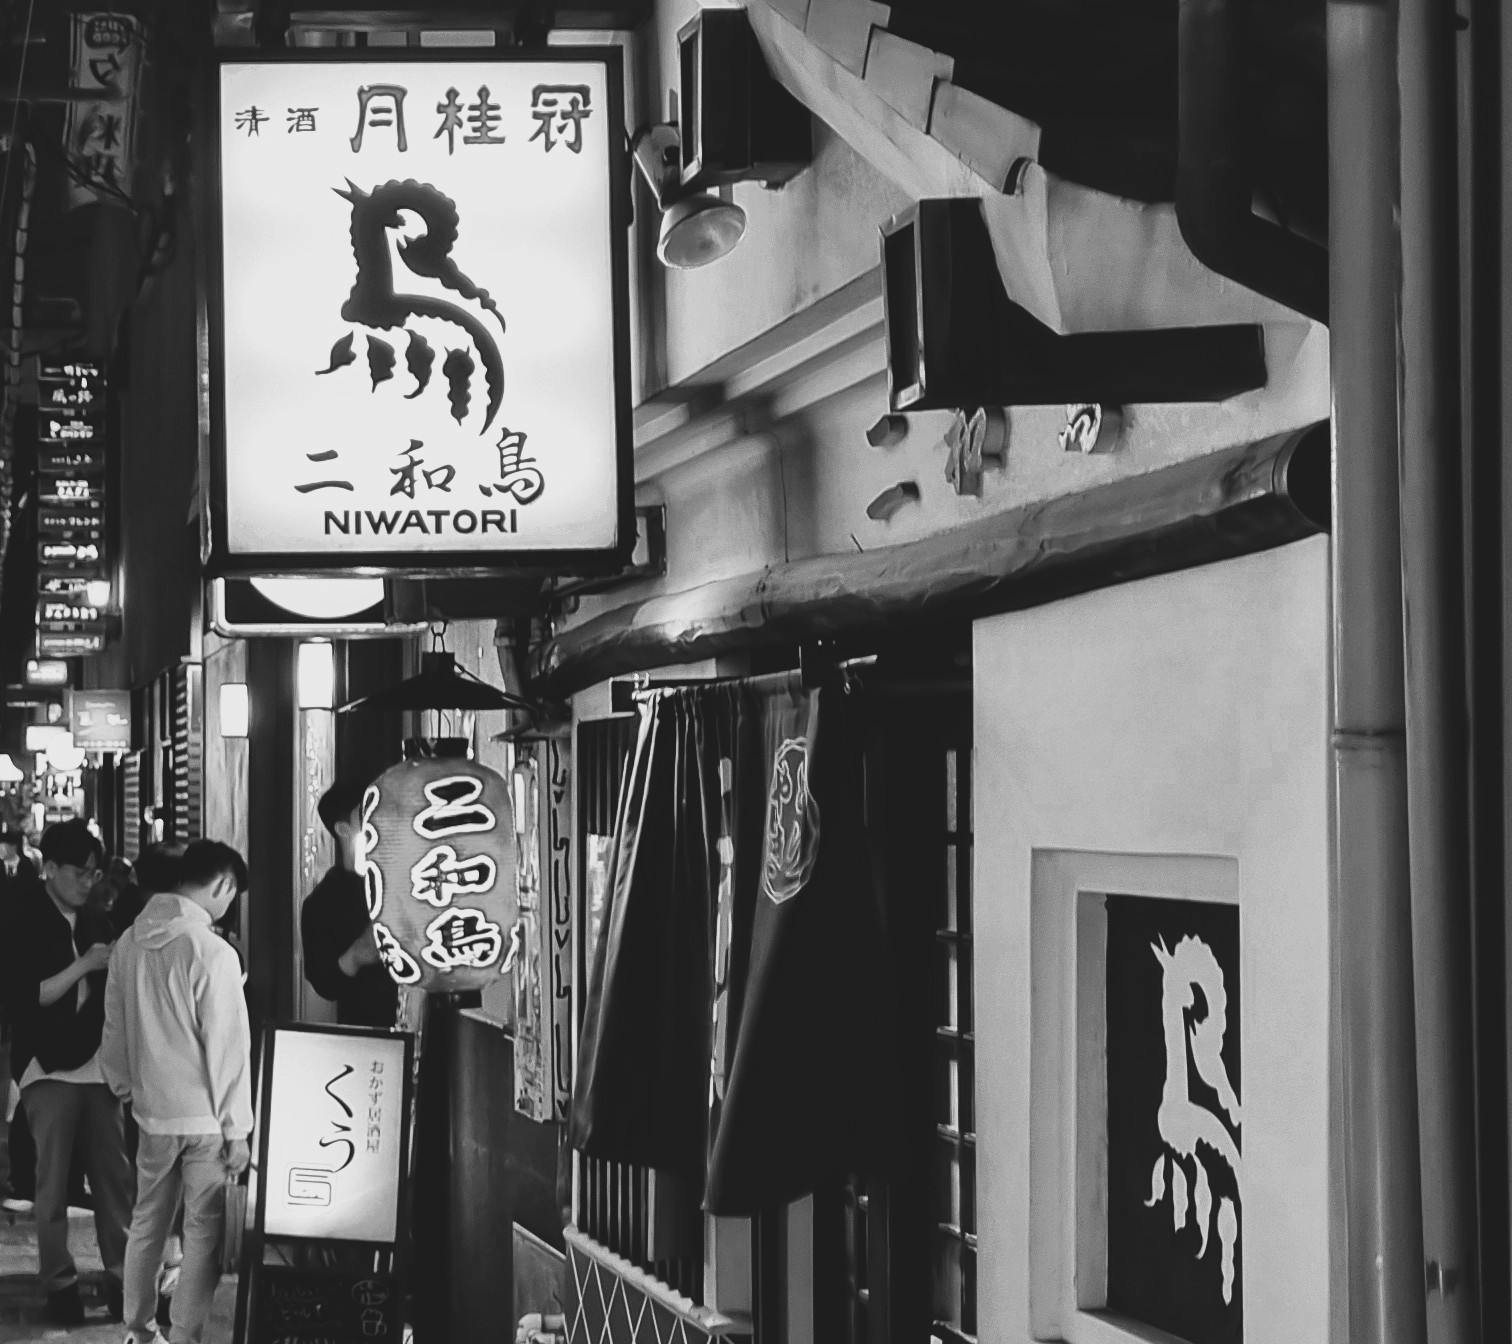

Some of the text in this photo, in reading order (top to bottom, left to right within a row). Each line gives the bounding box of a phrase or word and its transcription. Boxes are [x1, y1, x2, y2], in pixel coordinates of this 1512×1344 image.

[235, 84, 593, 155] 清酒 月桂冠
[294, 427, 545, 506] 二和鳥
[324, 508, 518, 535] NIWATORI
[411, 776, 501, 970] 二和鳥
